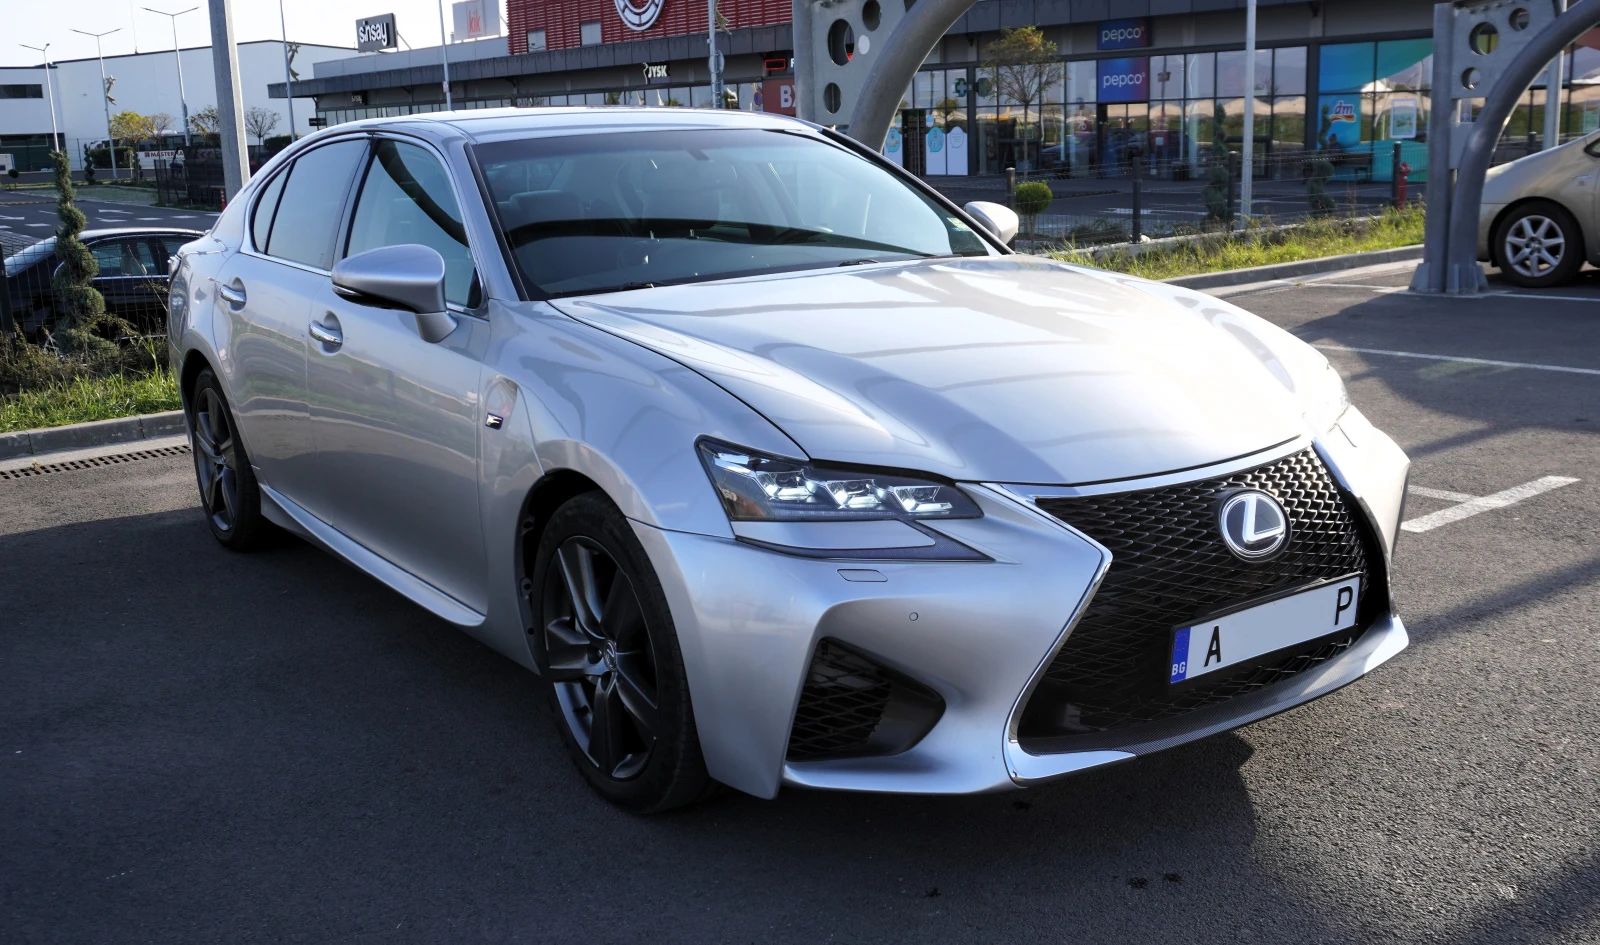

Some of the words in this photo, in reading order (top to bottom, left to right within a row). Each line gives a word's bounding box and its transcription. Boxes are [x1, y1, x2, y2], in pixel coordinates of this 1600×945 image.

[359, 20, 387, 46] sinsay
[648, 65, 668, 78] JYSK
[1335, 101, 1353, 115] dm
[1204, 625, 1222, 668] A
[1334, 585, 1354, 626] P
[1171, 661, 1186, 676] BG
